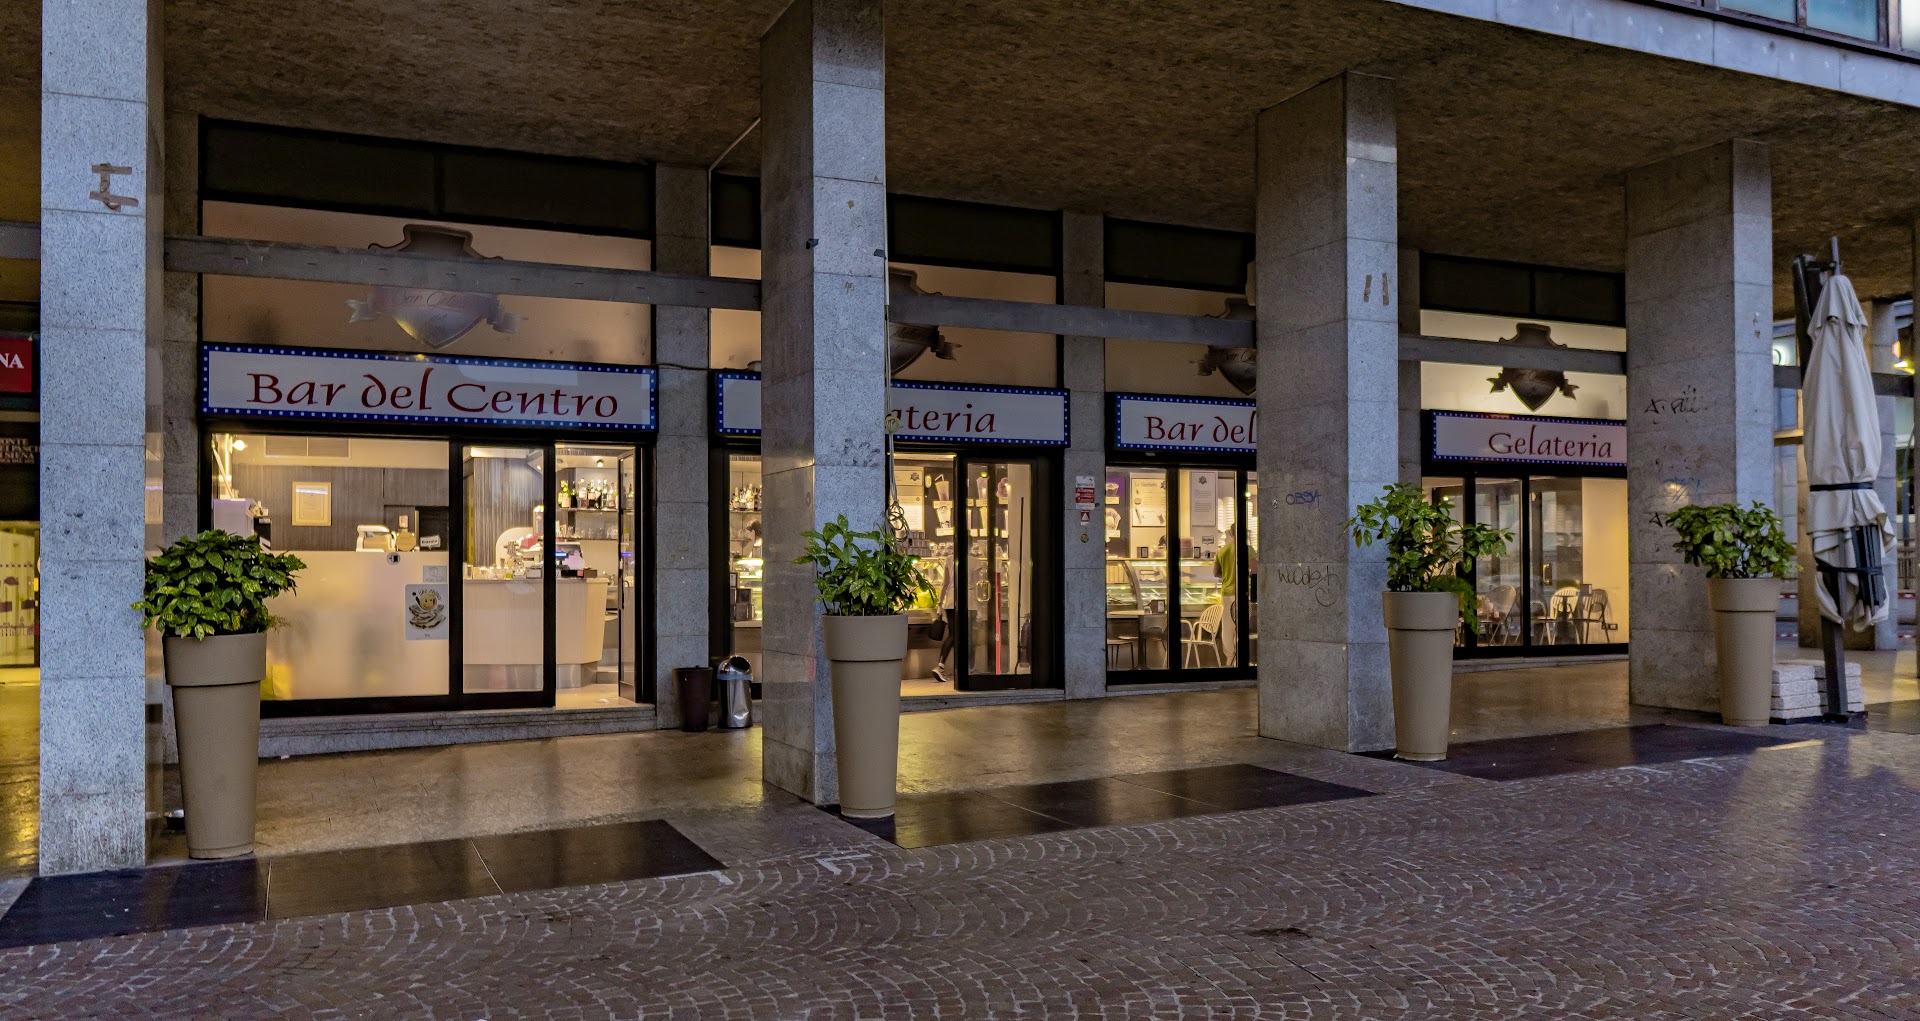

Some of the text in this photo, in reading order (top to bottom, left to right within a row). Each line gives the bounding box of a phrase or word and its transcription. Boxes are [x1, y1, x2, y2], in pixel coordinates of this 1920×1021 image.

[246, 367, 618, 418] Bar del Centro
[1143, 410, 1257, 444] Bar del
[1488, 424, 1612, 458] Gelateria
